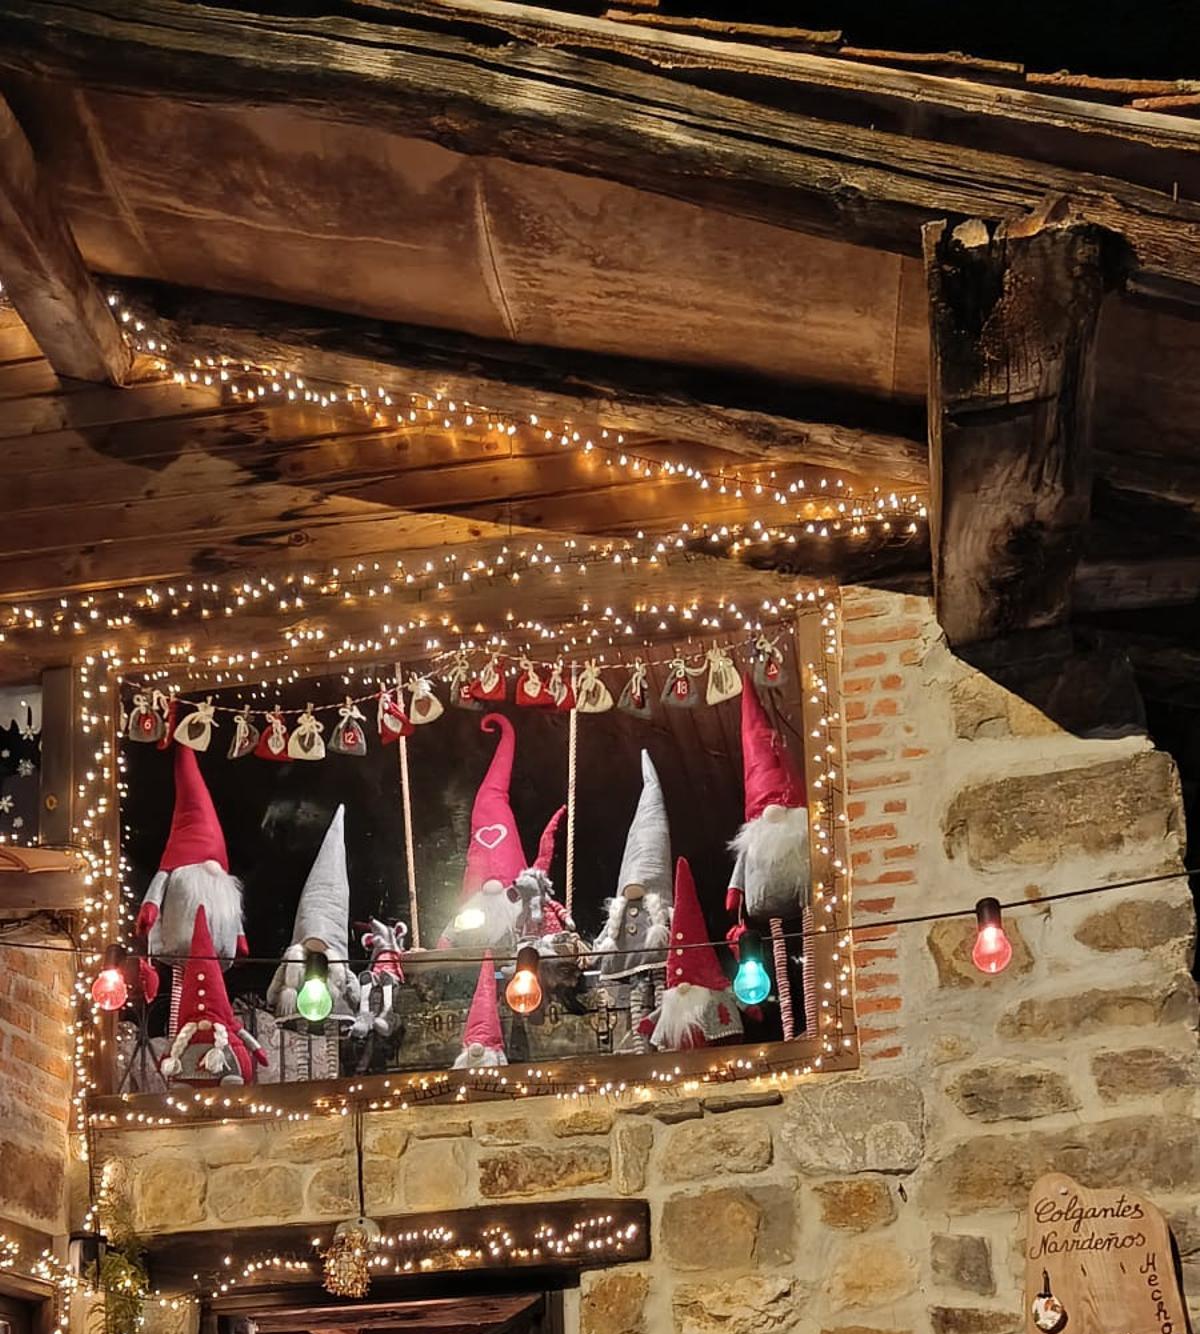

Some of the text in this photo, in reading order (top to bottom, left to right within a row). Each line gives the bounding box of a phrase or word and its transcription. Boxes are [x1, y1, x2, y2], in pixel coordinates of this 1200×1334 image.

[677, 680, 688, 695] 18
[144, 718, 151, 730] 6
[344, 732, 355, 744] 12
[1034, 1194, 1145, 1233] Colgantes
[1029, 1231, 1146, 1260] Navideños
